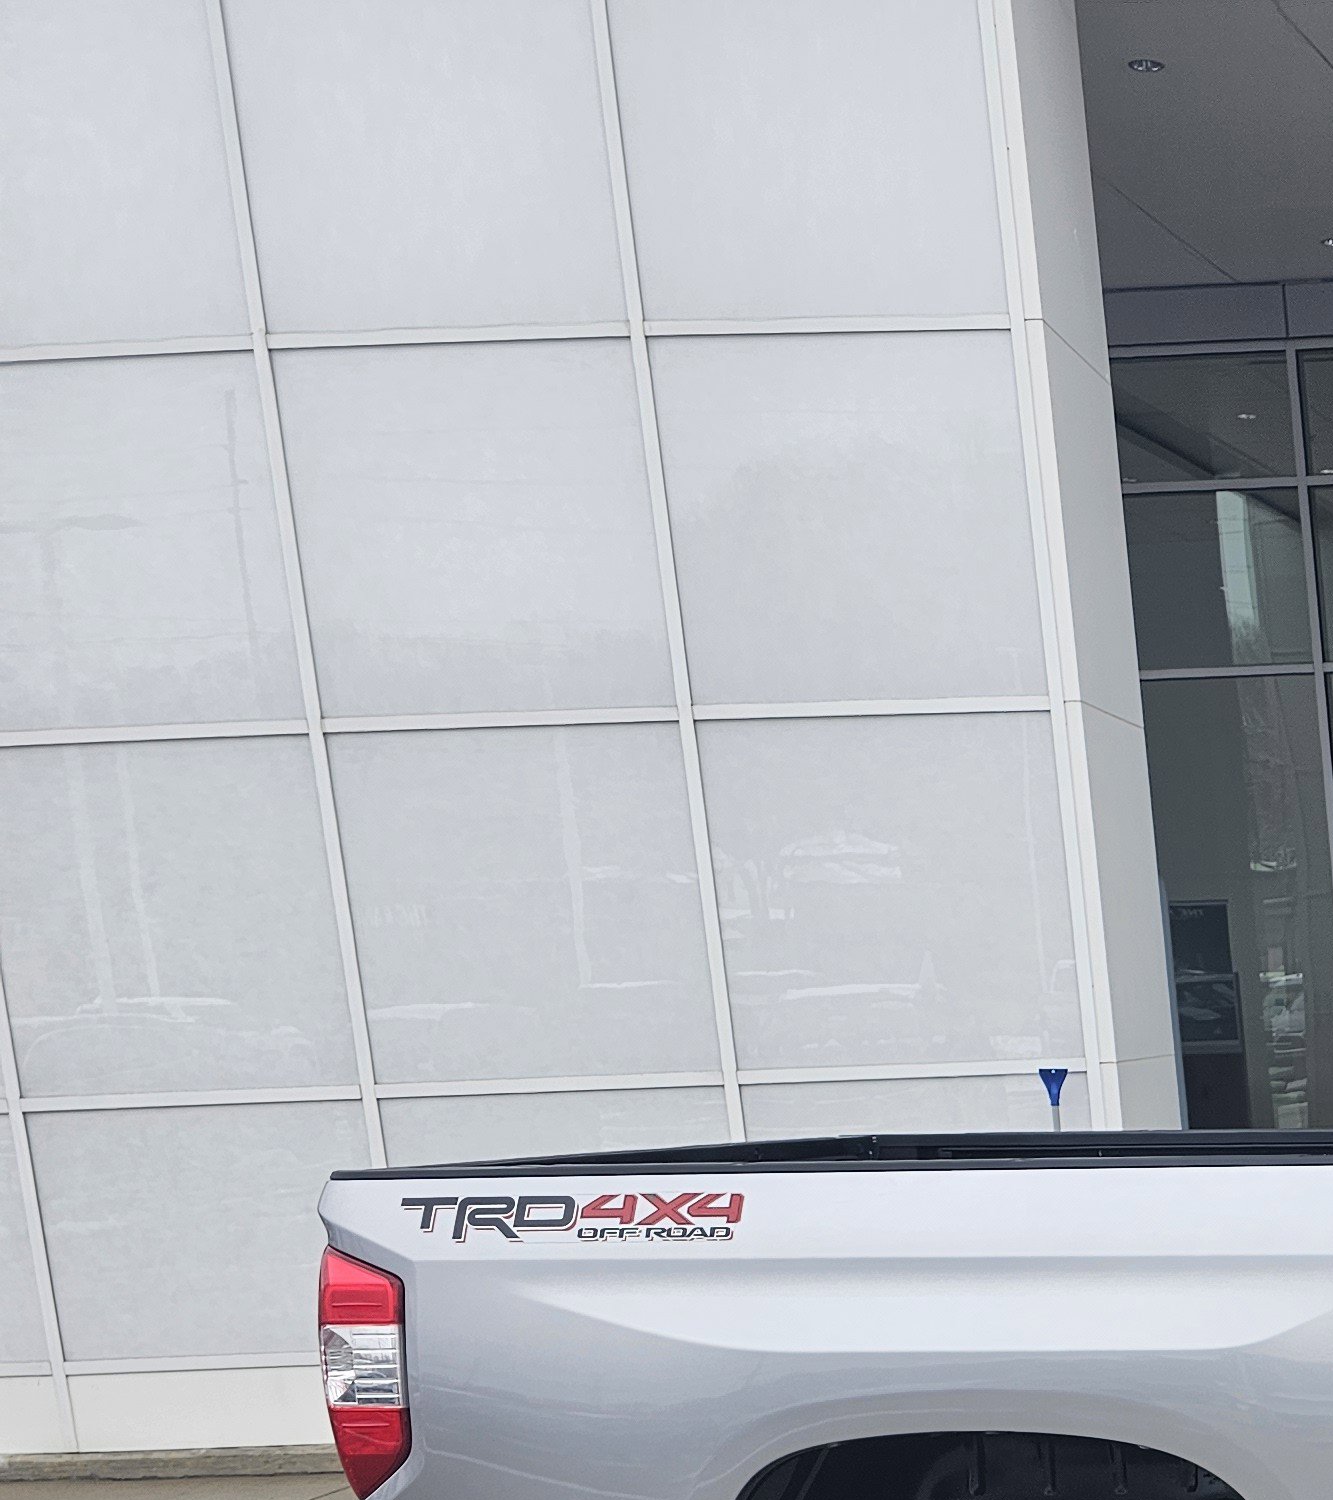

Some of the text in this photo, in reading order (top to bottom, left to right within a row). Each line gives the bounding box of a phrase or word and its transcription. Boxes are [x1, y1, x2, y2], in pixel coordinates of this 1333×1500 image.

[400, 1196, 578, 1242] TRD
[576, 1227, 734, 1241] OFF ROAD
